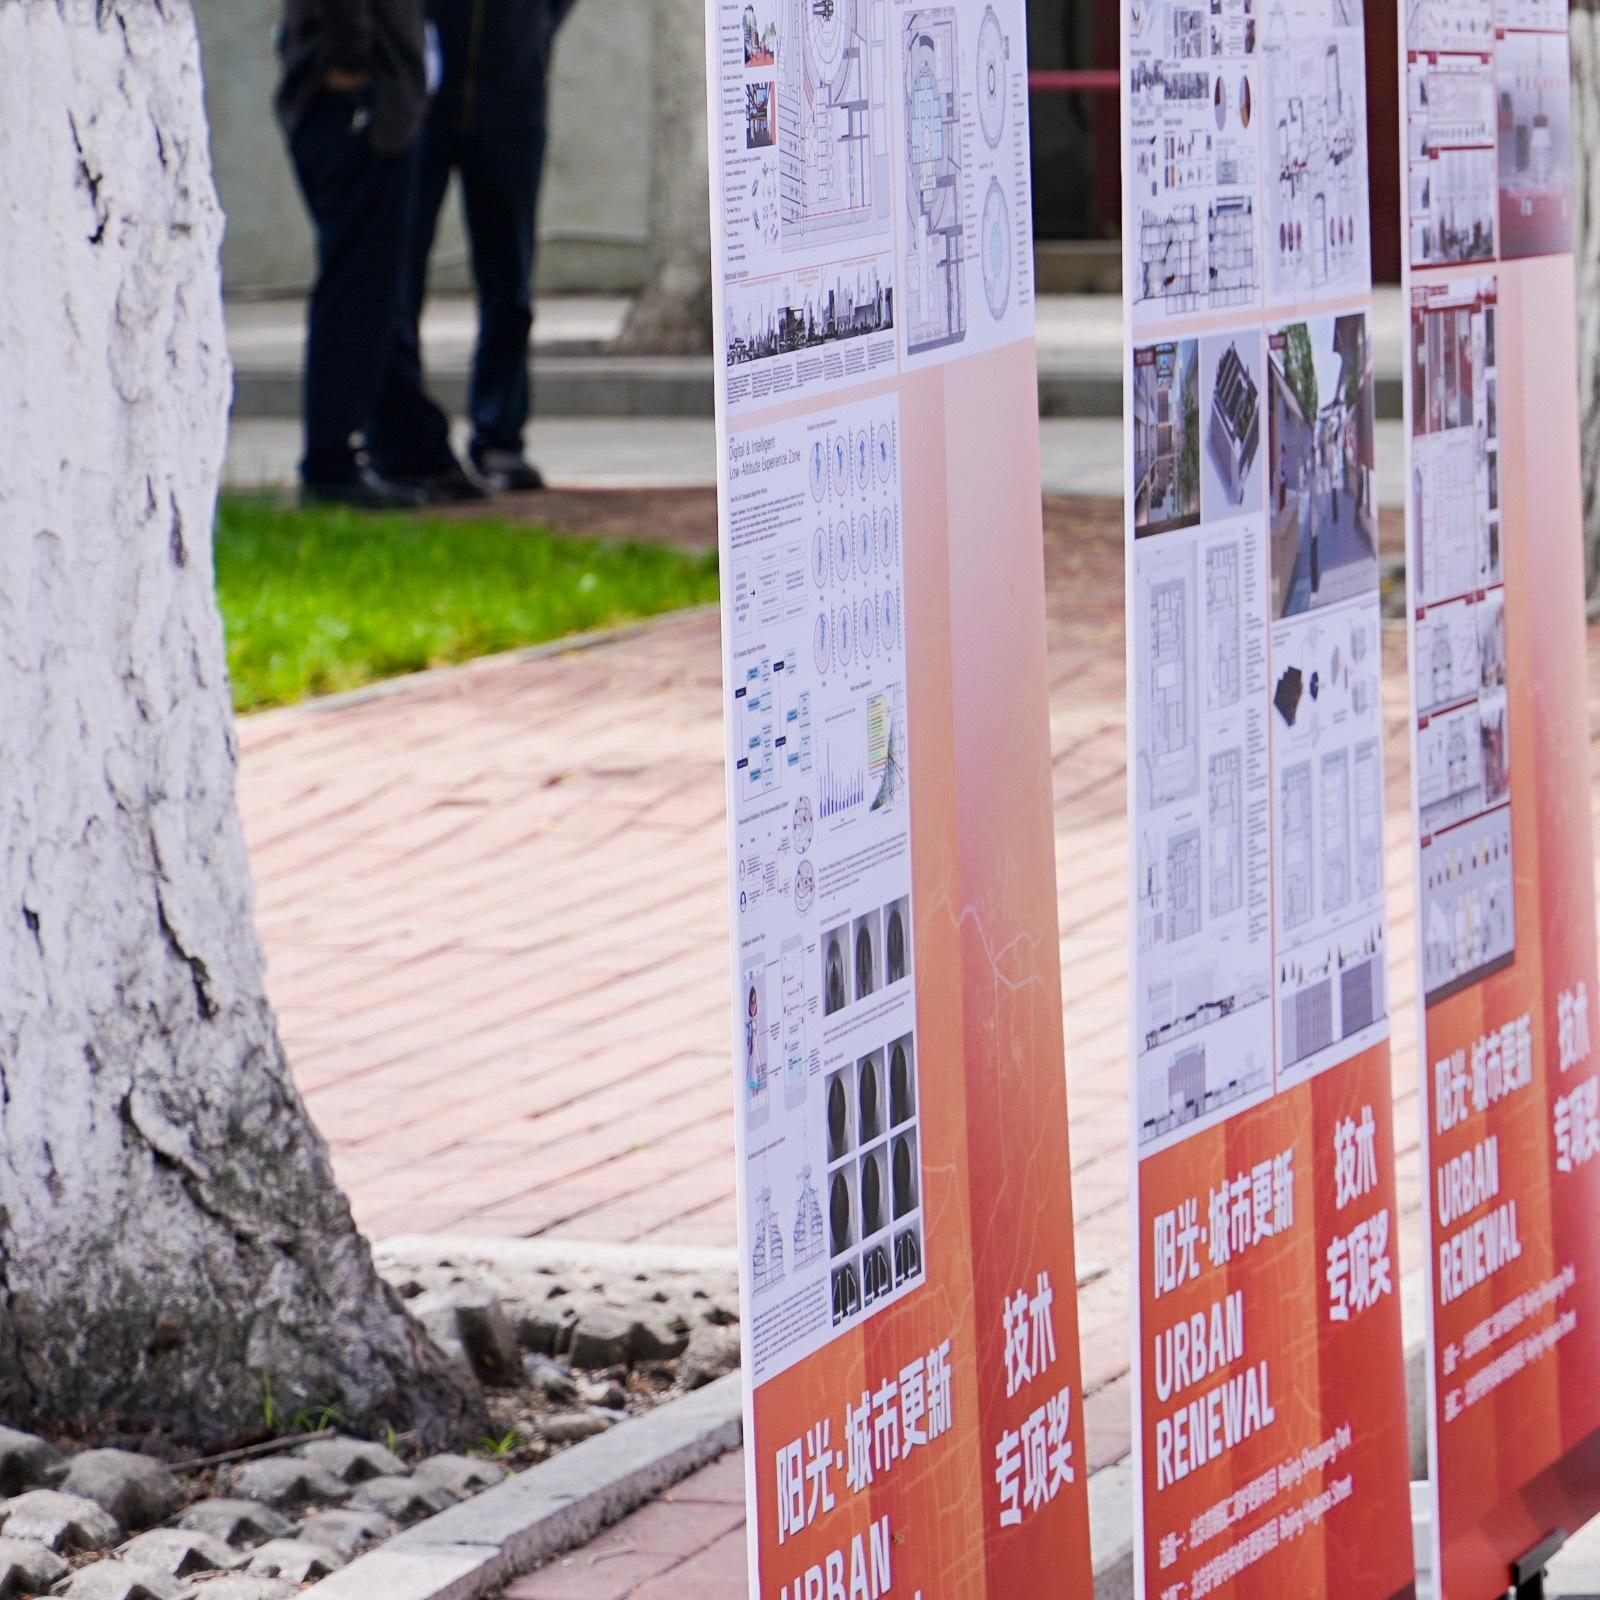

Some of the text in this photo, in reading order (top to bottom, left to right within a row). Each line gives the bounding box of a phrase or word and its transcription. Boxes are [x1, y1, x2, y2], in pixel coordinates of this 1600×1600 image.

[1333, 1104, 1378, 1211] 技术
[1437, 1134, 1499, 1229] URBAN
[1153, 1147, 1296, 1299] 阳光·城市更新
[1325, 1208, 1392, 1323] 专项奖
[1439, 1199, 1522, 1307] RENEWAL
[1003, 1271, 1057, 1398] 技术
[1154, 1289, 1244, 1403] URBAN
[776, 1339, 954, 1545] 阳光·城市更新
[995, 1386, 1075, 1528] 专项奖
[1156, 1360, 1275, 1492] RENEWAL
